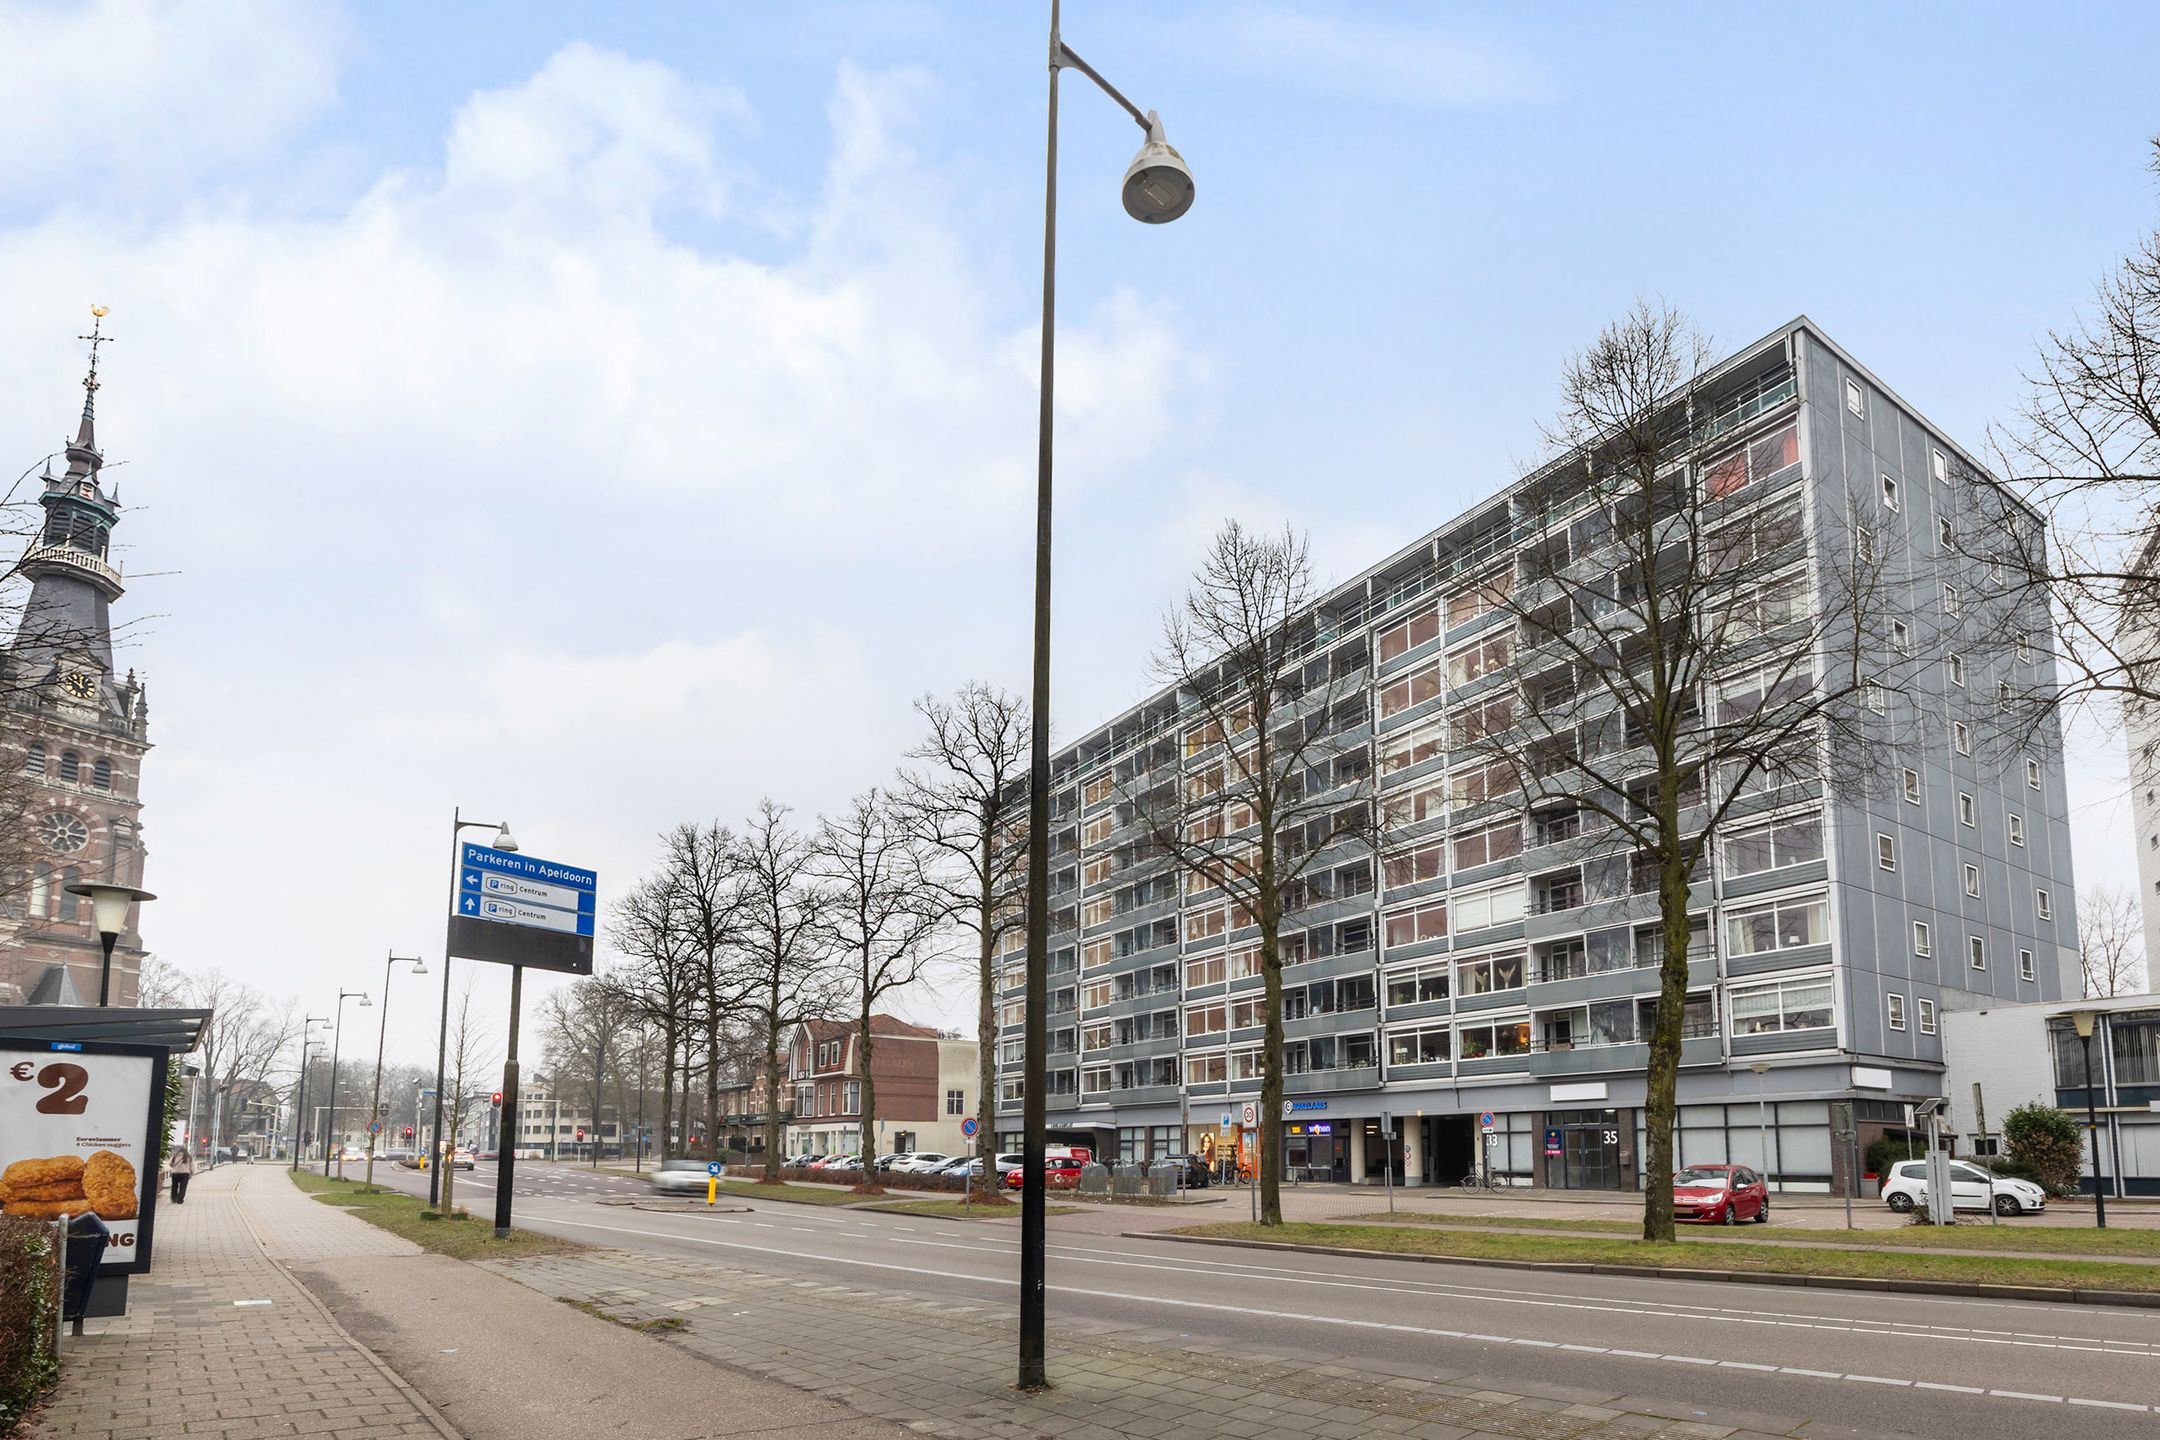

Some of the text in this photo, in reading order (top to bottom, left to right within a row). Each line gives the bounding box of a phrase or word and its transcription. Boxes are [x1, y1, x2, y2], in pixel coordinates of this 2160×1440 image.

[468, 848, 593, 886] Parkeren in Apeldoorn
[500, 883, 514, 892] ring
[519, 886, 548, 897] Centrum
[498, 906, 513, 915] ring
[517, 909, 547, 920] Centrum
[1603, 1130, 1618, 1144] 35
